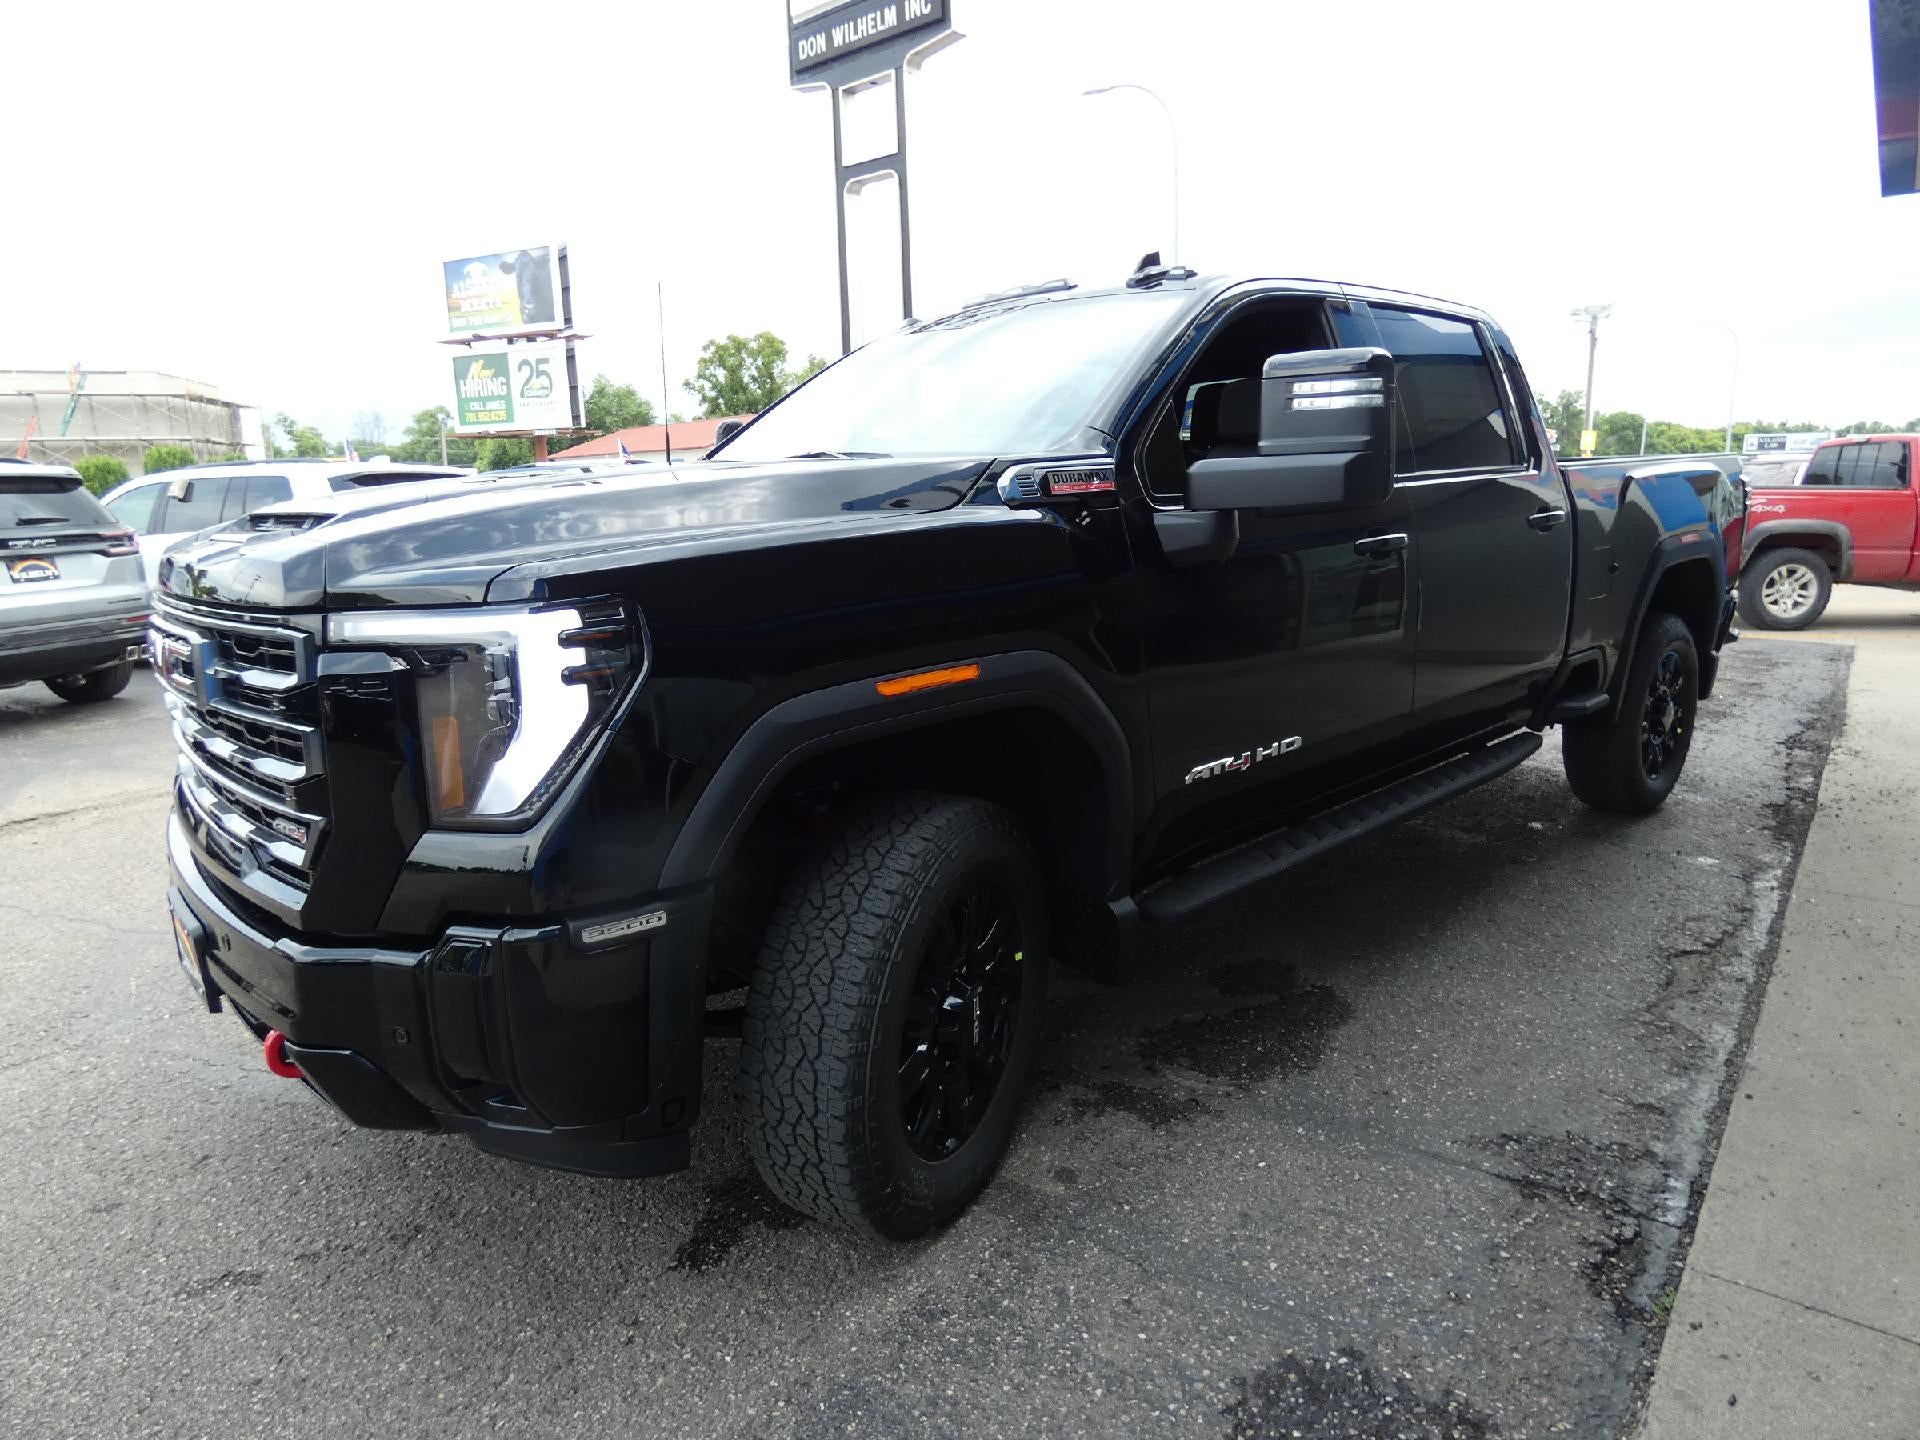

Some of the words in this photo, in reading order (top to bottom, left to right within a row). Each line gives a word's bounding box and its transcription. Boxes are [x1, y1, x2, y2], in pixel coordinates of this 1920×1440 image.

[798, 32, 827, 61] DON
[831, 5, 898, 47] WILHELM
[904, 0, 932, 21] INC
[459, 376, 508, 400] HIRING
[517, 357, 553, 399] 25
[1051, 471, 1109, 485] DURAMAX
[8, 538, 57, 550] GMC
[1184, 751, 1251, 785] AT4
[1256, 735, 1303, 762] HD
